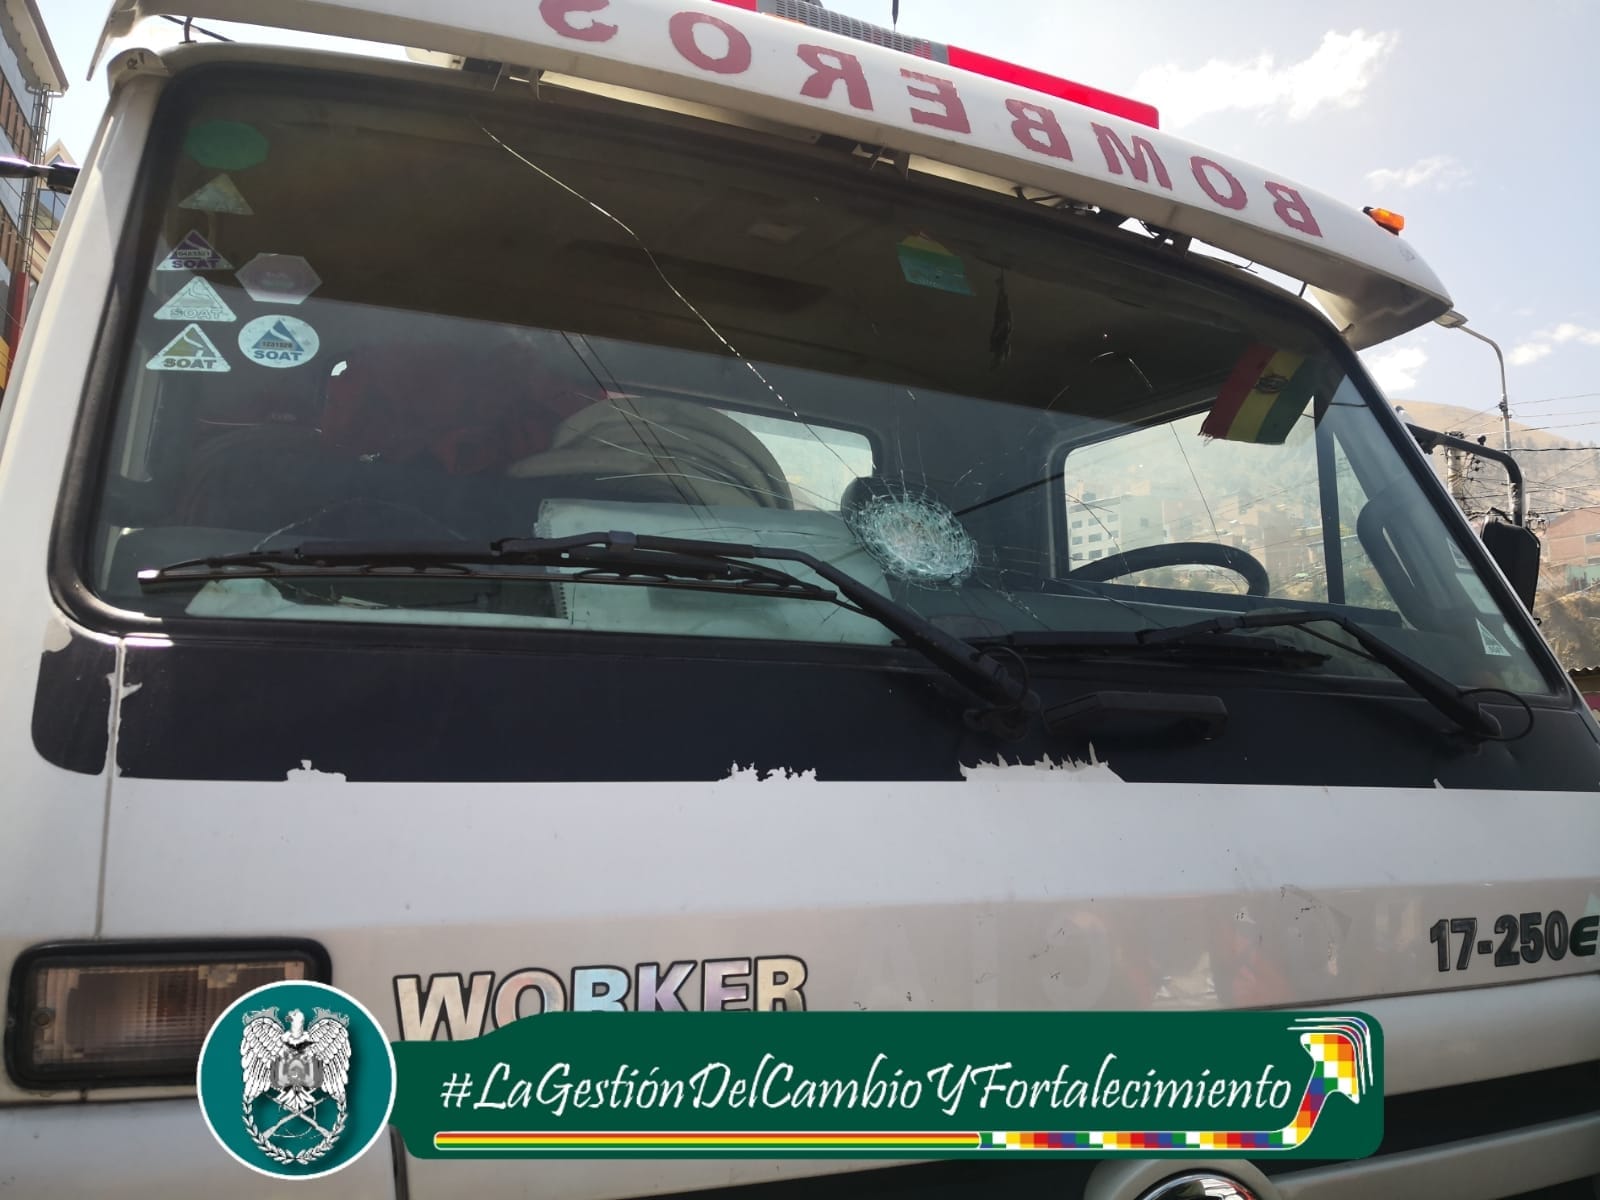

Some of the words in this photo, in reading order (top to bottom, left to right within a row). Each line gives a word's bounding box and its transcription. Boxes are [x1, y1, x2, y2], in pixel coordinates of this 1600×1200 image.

[171, 259, 219, 269] SOAT
[170, 308, 224, 320] SOAT
[253, 350, 303, 361] SOAT
[163, 358, 217, 370] SOAT
[393, 955, 808, 1041] WORKER
